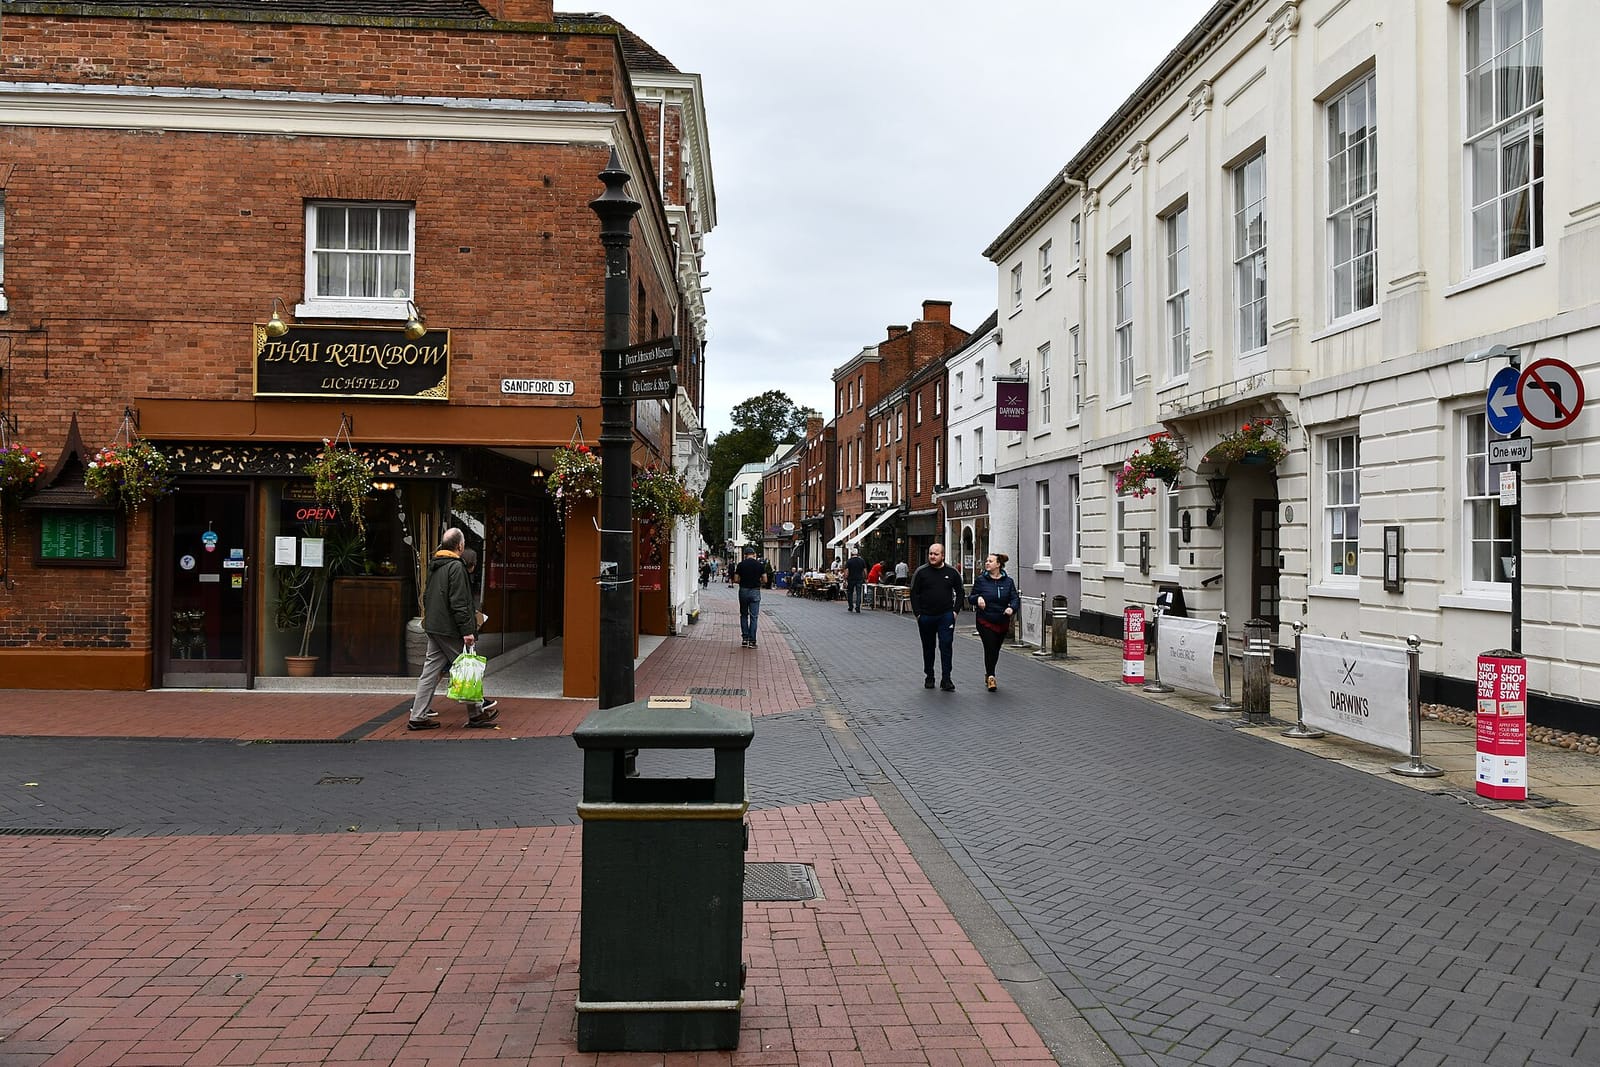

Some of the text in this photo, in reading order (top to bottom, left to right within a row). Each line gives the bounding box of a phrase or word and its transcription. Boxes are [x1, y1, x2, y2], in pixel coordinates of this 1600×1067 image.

[264, 340, 448, 370] THAI RAINBOW
[320, 376, 400, 390] LICHFIELD
[504, 381, 571, 394] SANDFORD ST
[999, 407, 1025, 415] DARWIN'S
[1493, 446, 1527, 458] One way
[296, 508, 337, 520] OPEN
[1478, 662, 1496, 672] VISIT
[1501, 664, 1522, 674] VISIT
[1478, 671, 1498, 681] SHOP
[1500, 673, 1525, 682] SHOP
[1478, 680, 1494, 689] DINE
[1500, 682, 1520, 691] DINE
[1478, 688, 1494, 698] STAY
[1500, 691, 1520, 700] STAY
[1330, 690, 1369, 718] DARWIN'S
